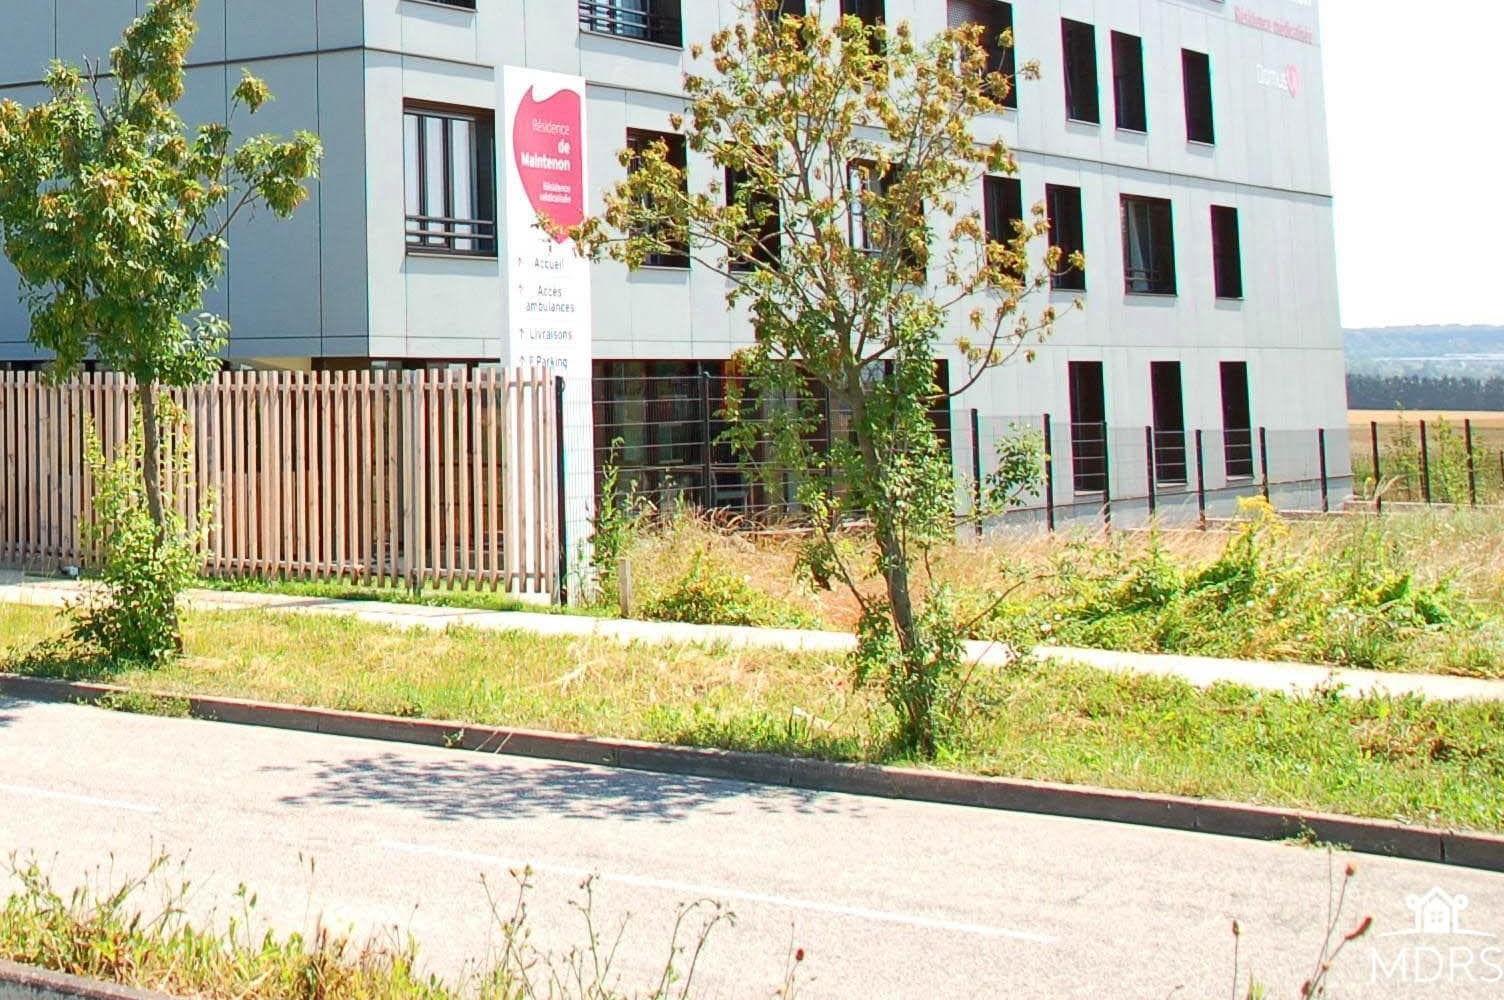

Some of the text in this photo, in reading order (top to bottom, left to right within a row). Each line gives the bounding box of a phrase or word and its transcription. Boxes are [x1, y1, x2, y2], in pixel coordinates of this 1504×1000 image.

[558, 139, 571, 155] de
[521, 151, 571, 171] Maintenon
[526, 302, 575, 313] ambulances
[529, 327, 573, 340] Livraisons
